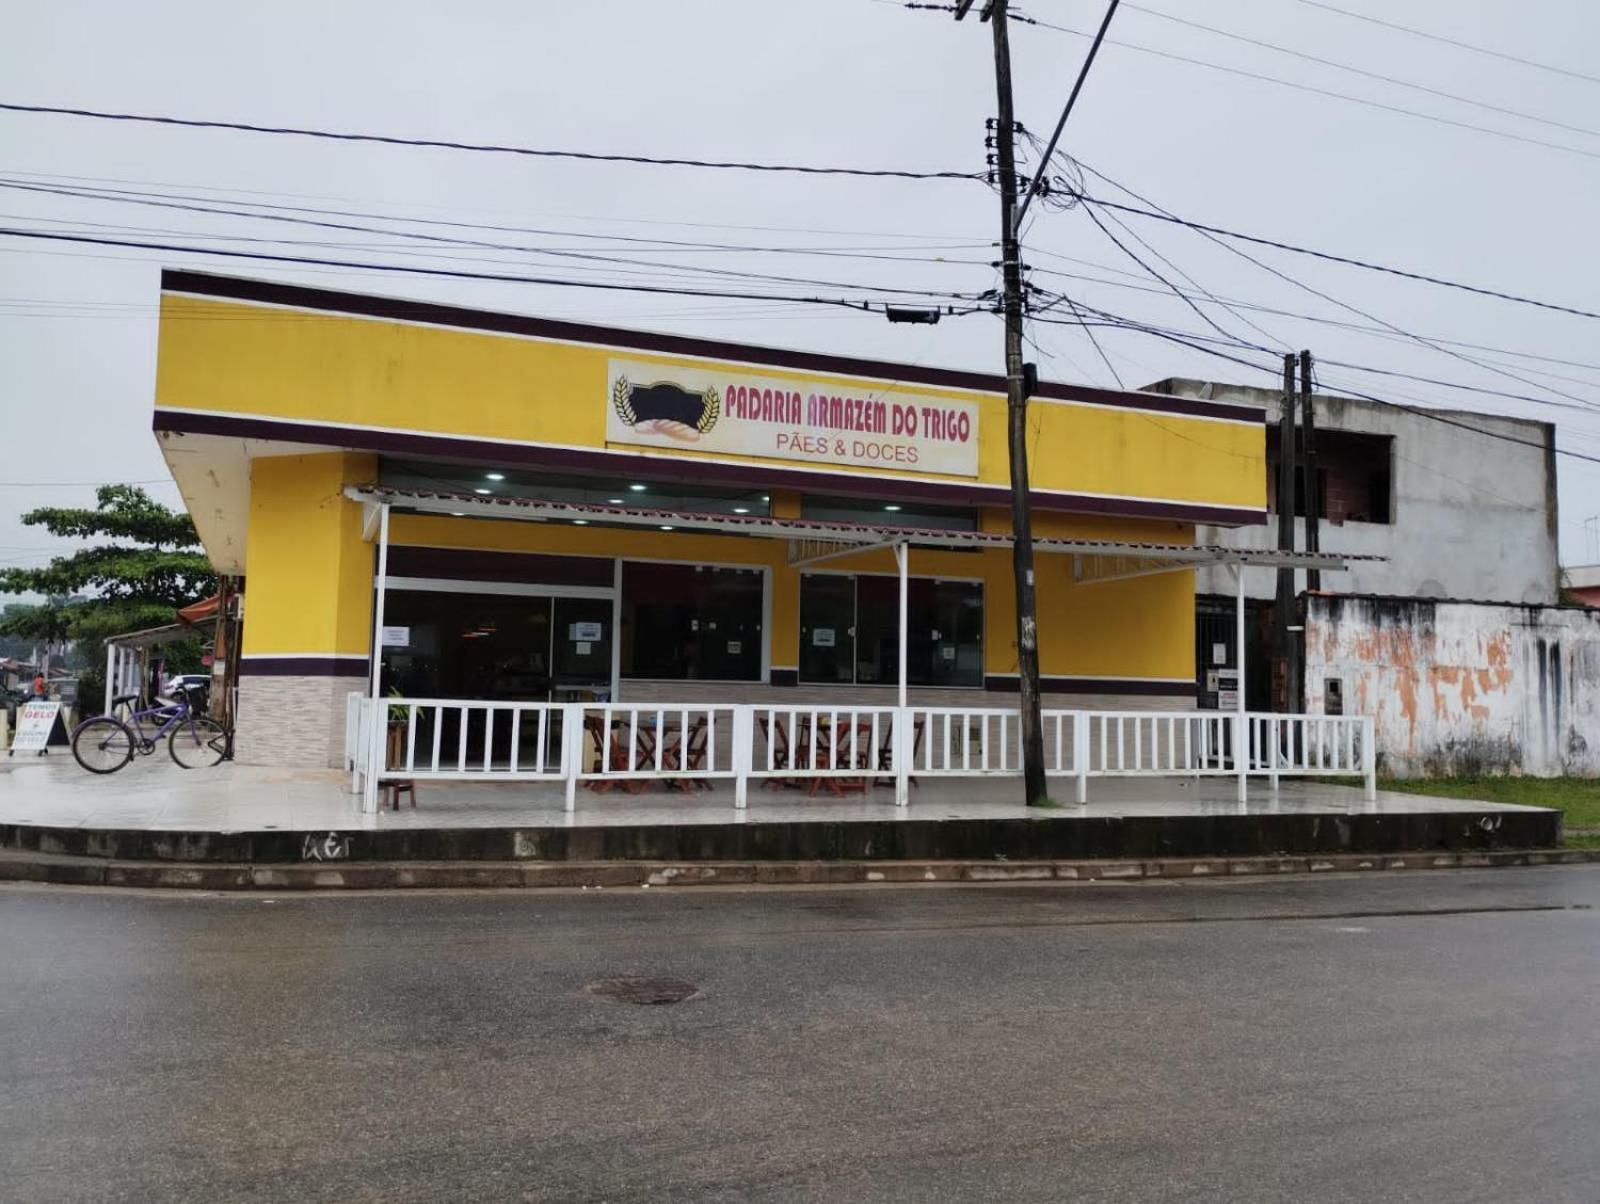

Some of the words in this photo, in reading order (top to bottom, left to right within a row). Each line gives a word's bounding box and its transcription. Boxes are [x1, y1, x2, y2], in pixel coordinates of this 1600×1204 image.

[725, 384, 802, 425] PADARIA
[807, 393, 886, 434] ARMAZÉM
[892, 404, 918, 437] DO
[922, 407, 970, 442] TRIGO
[776, 431, 828, 455] PÃES
[834, 439, 846, 456] &
[853, 442, 919, 464] DOCES
[24, 711, 55, 719] GELO
